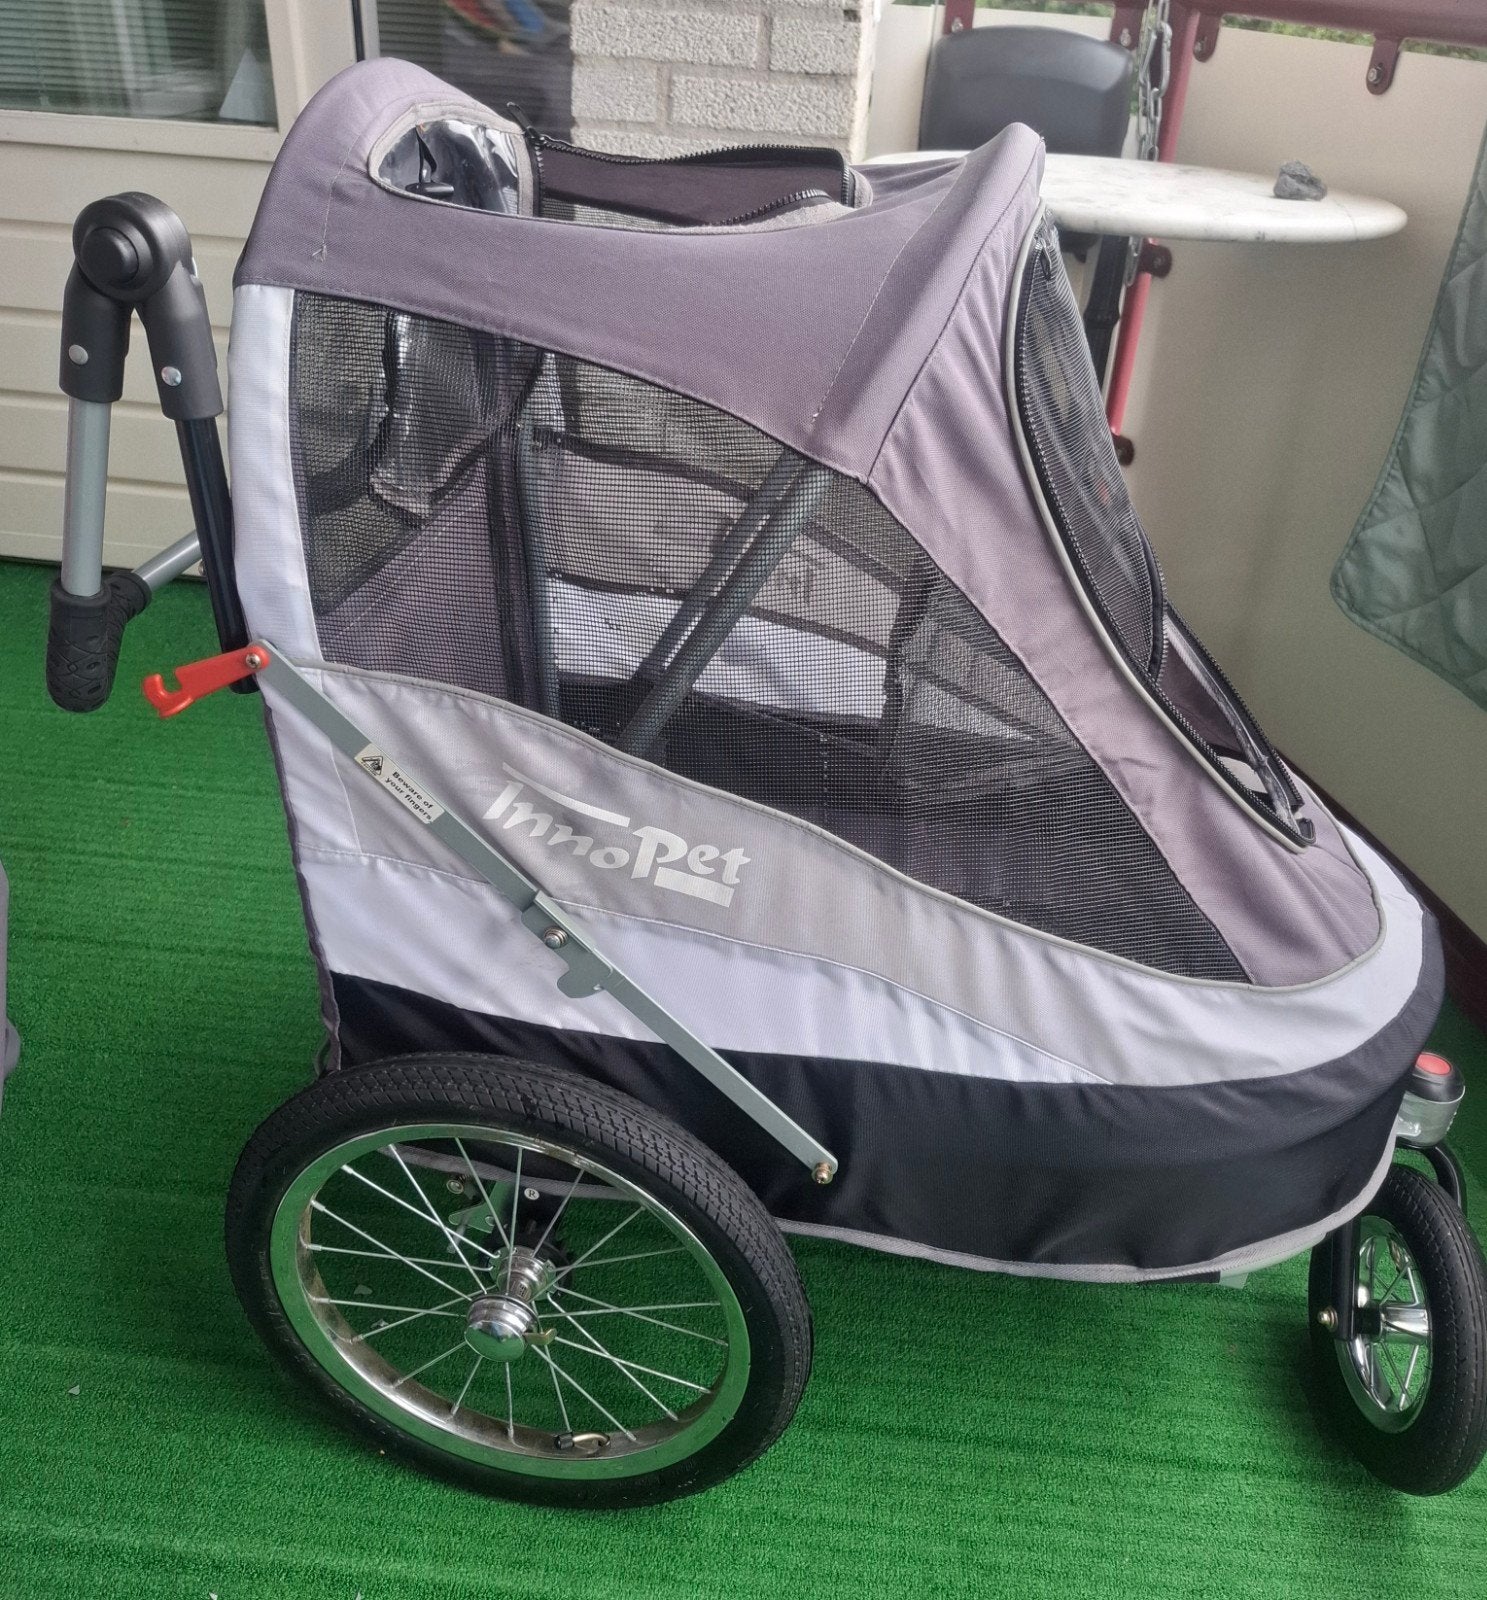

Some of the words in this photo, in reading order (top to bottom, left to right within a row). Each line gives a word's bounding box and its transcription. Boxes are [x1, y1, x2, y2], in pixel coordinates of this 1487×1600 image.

[385, 777, 405, 794] your
[404, 794, 432, 820] fingers
[392, 771, 422, 800] Beware
[423, 800, 434, 809] of
[482, 780, 751, 885] InnoPet
